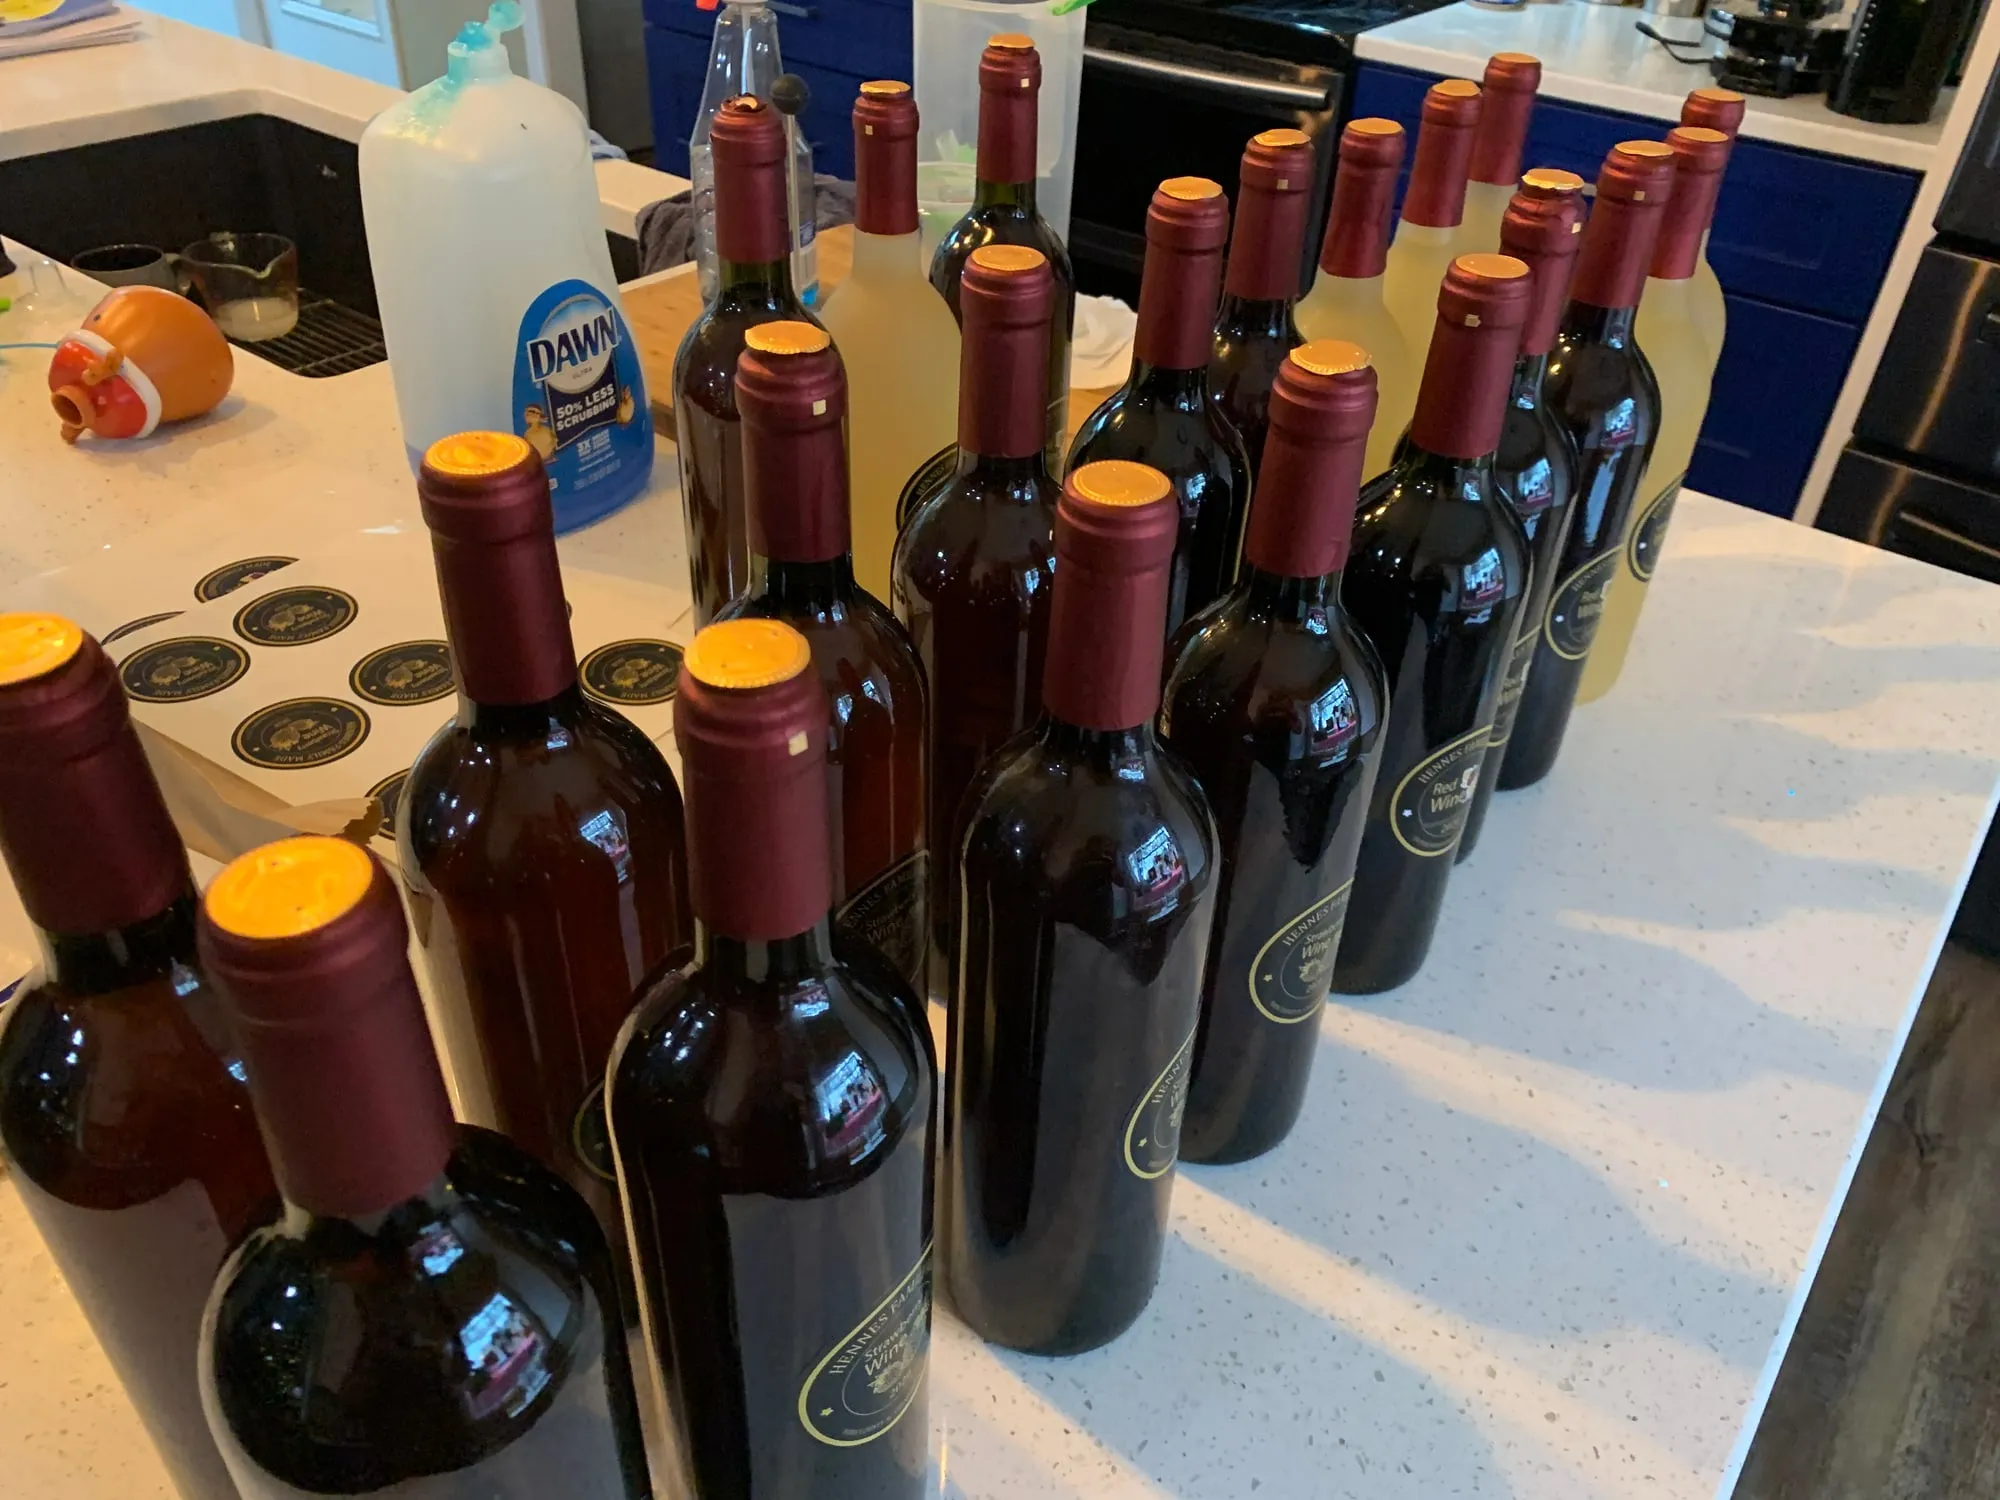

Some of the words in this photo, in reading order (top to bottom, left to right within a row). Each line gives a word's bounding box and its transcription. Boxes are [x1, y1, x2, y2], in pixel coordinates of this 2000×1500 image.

[527, 306, 620, 383] DAWN
[556, 400, 583, 419] 50%
[585, 384, 615, 407] LESS
[556, 398, 616, 431] SCRUBBING
[1432, 778, 1460, 796] Red
[1282, 905, 1329, 946] HENNES
[829, 1312, 889, 1375] HENNES
[864, 1333, 908, 1377] Wine
